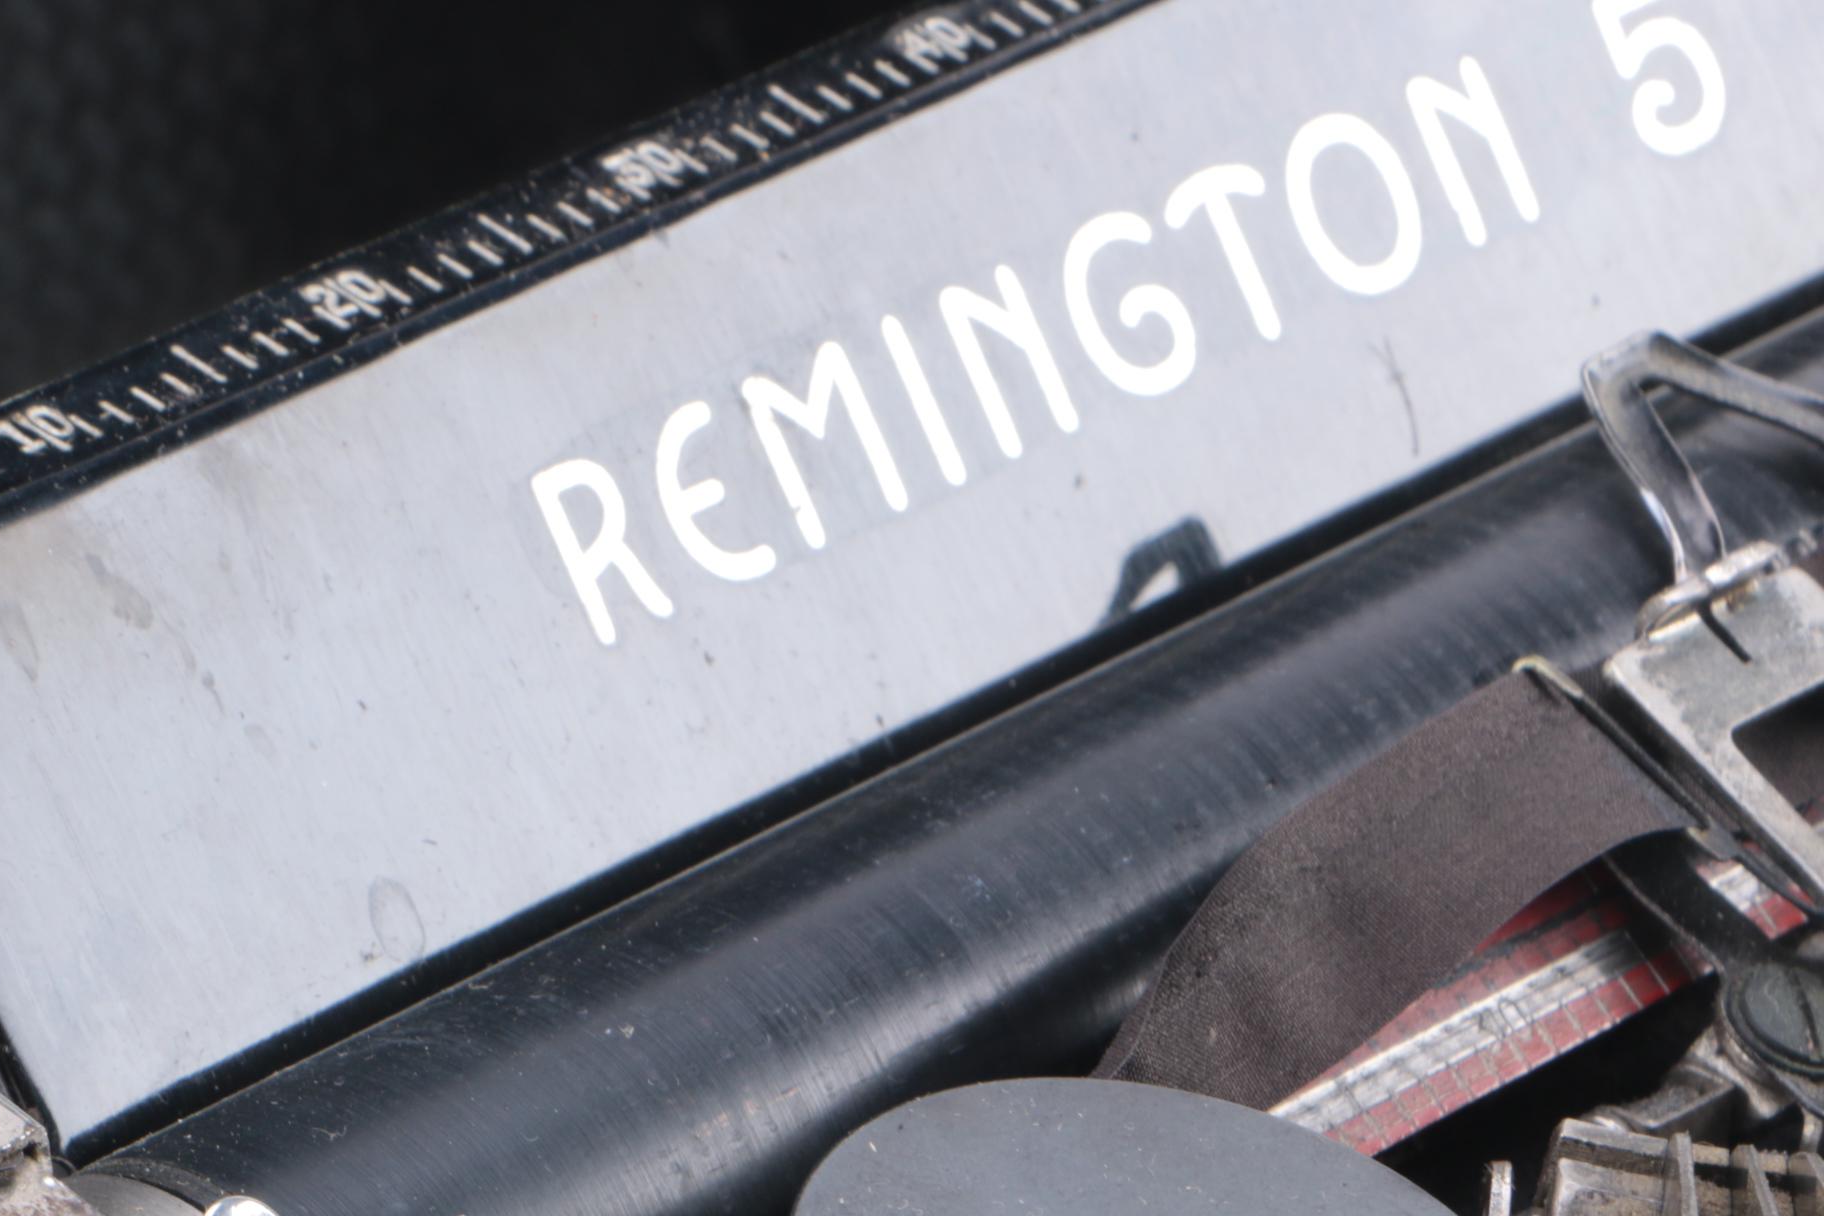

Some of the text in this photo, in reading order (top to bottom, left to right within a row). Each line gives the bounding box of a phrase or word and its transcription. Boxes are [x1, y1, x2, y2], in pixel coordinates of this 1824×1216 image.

[298, 269, 385, 329] 20
[531, 0, 1726, 646] REMINGTON 5
